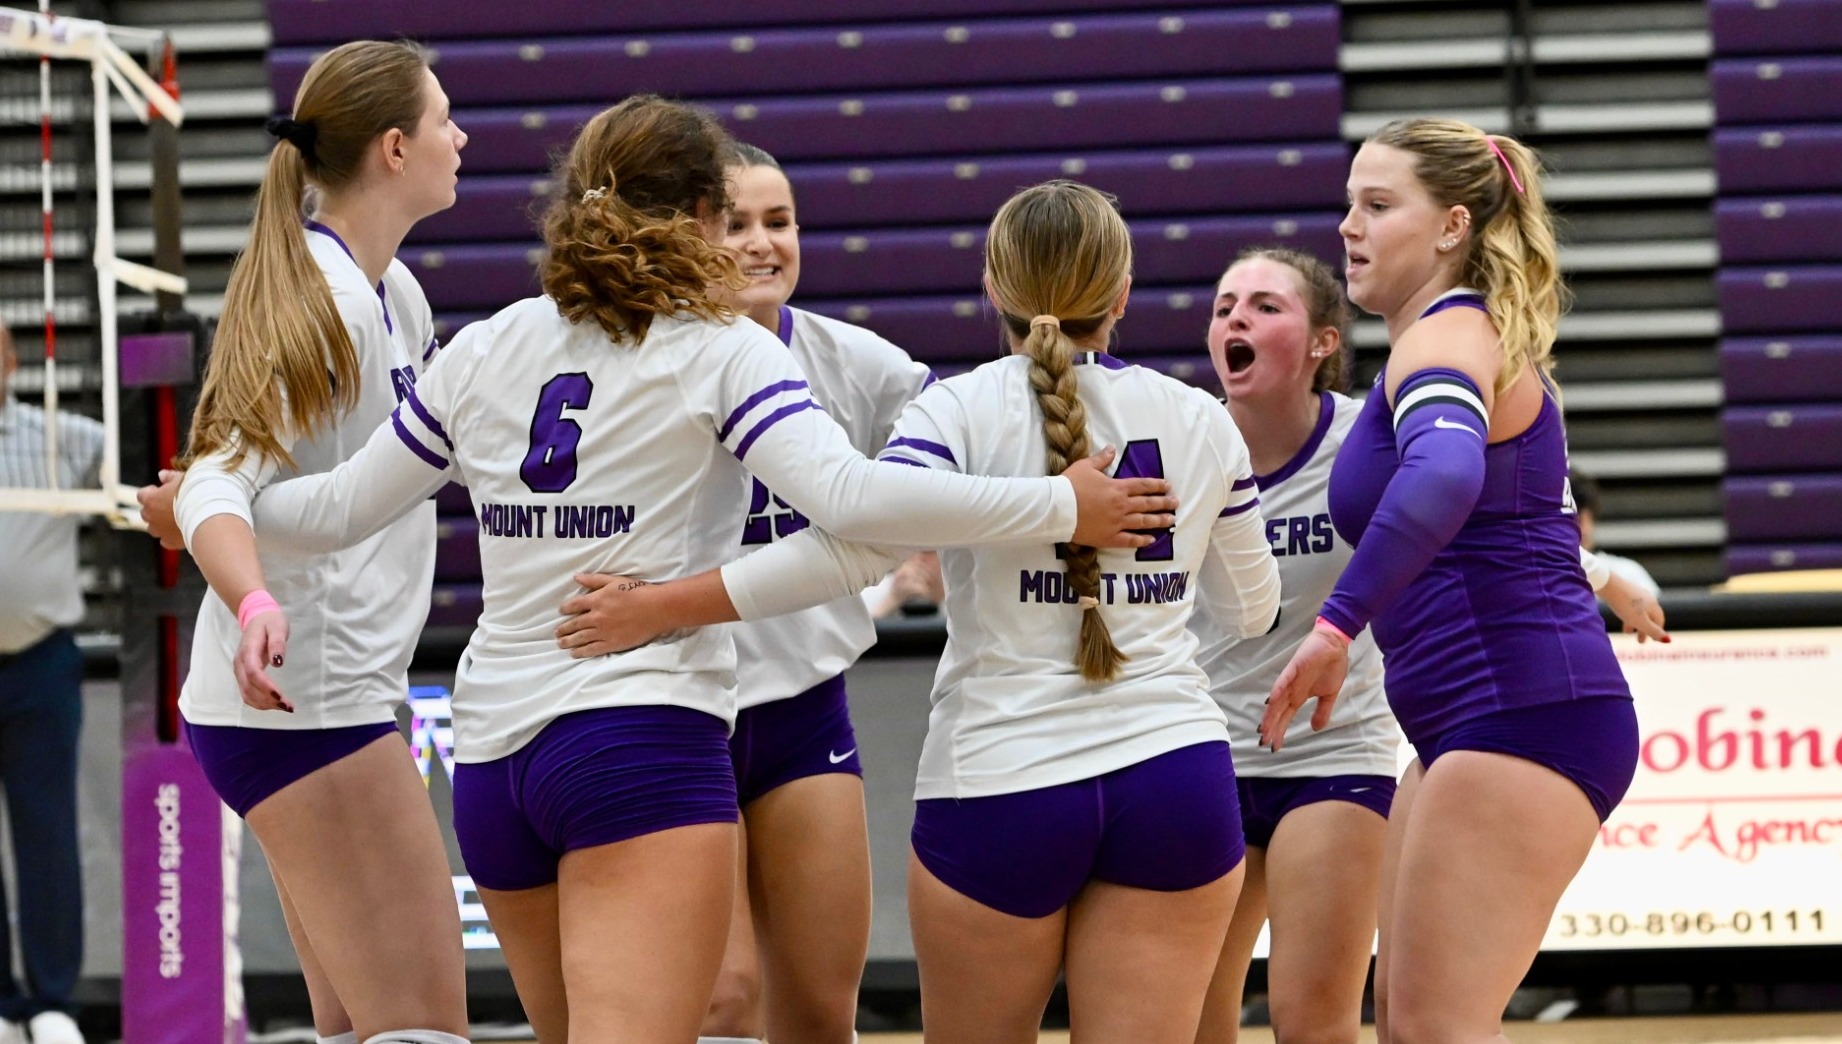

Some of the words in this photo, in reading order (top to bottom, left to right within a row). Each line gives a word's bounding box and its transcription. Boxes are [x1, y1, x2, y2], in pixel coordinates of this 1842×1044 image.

[519, 371, 594, 494] 6
[481, 502, 547, 538] MOUNT
[554, 504, 635, 539] UNION
[1056, 438, 1177, 562] 4
[1265, 513, 1334, 557] ERS
[1020, 569, 1118, 606] MOUT
[1125, 571, 1190, 604] UNION
[1640, 707, 1842, 774] obin
[154, 783, 184, 872] sports
[154, 871, 184, 979] imports
[1559, 908, 1824, 938] 330-896-0111
